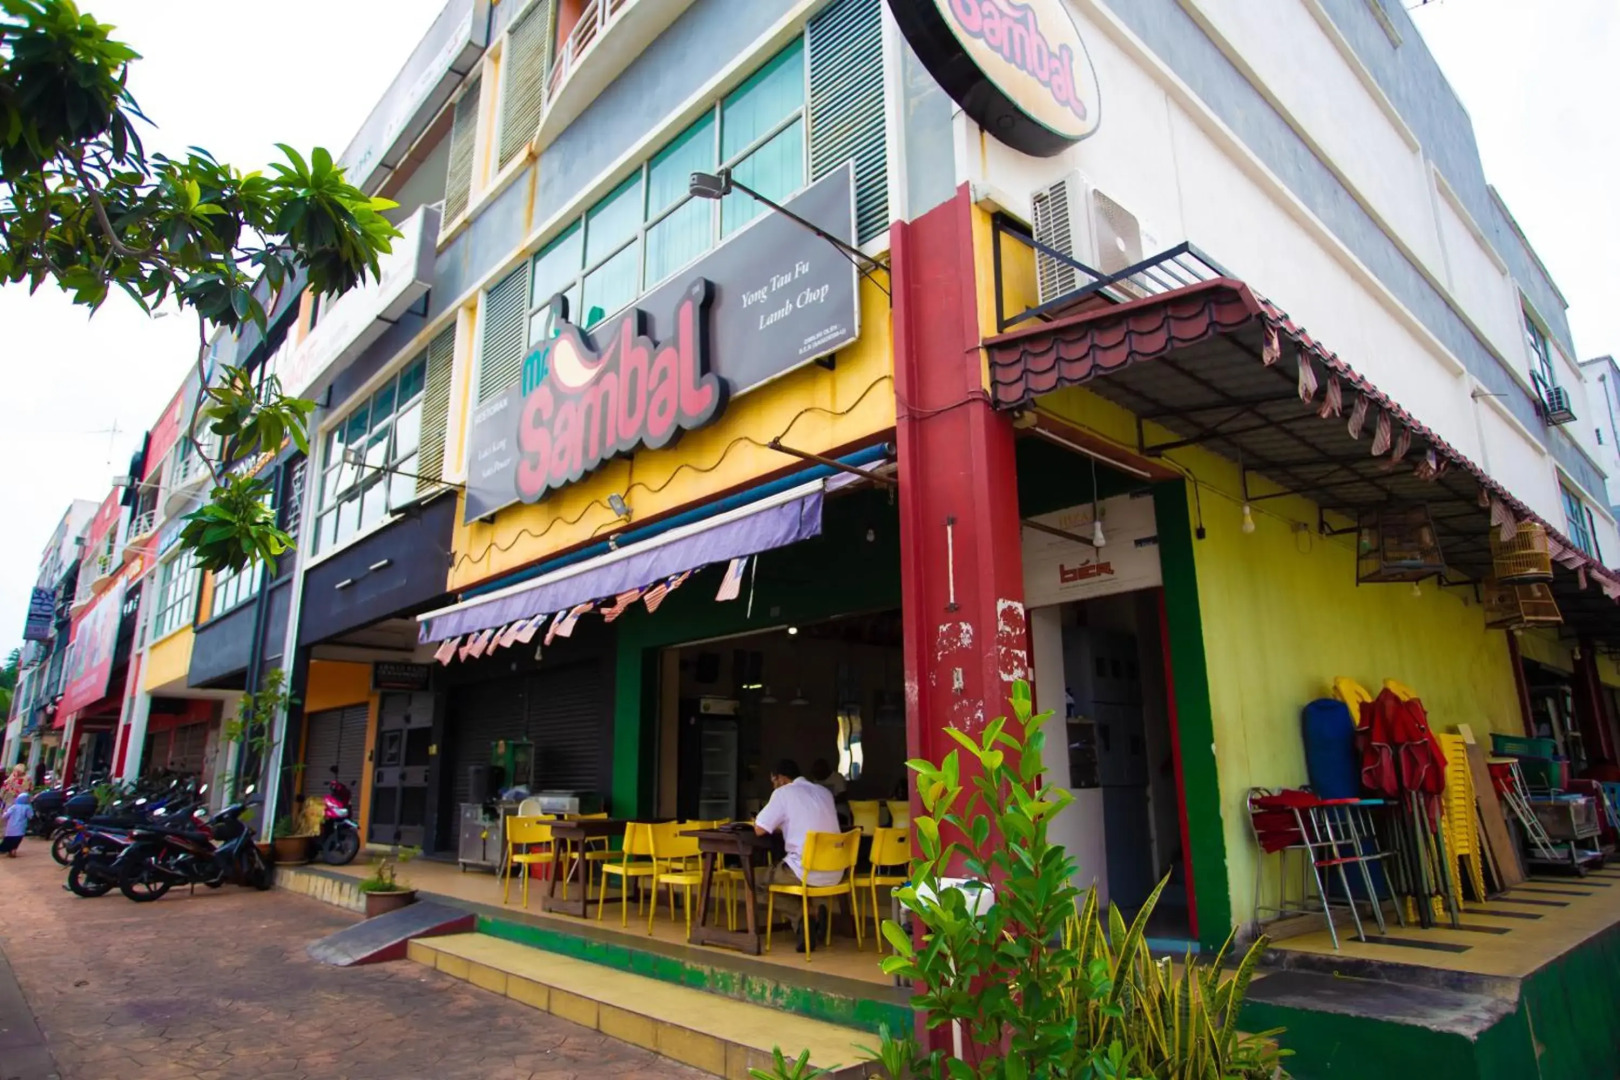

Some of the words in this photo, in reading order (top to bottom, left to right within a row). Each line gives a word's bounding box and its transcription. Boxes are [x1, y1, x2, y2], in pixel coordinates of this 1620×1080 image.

[741, 286, 769, 309] Yong
[769, 274, 792, 292] Tau
[793, 261, 810, 280] Fu
[759, 299, 793, 331] Lamb
[796, 284, 829, 309] Chop
[517, 298, 714, 497] Sambal
